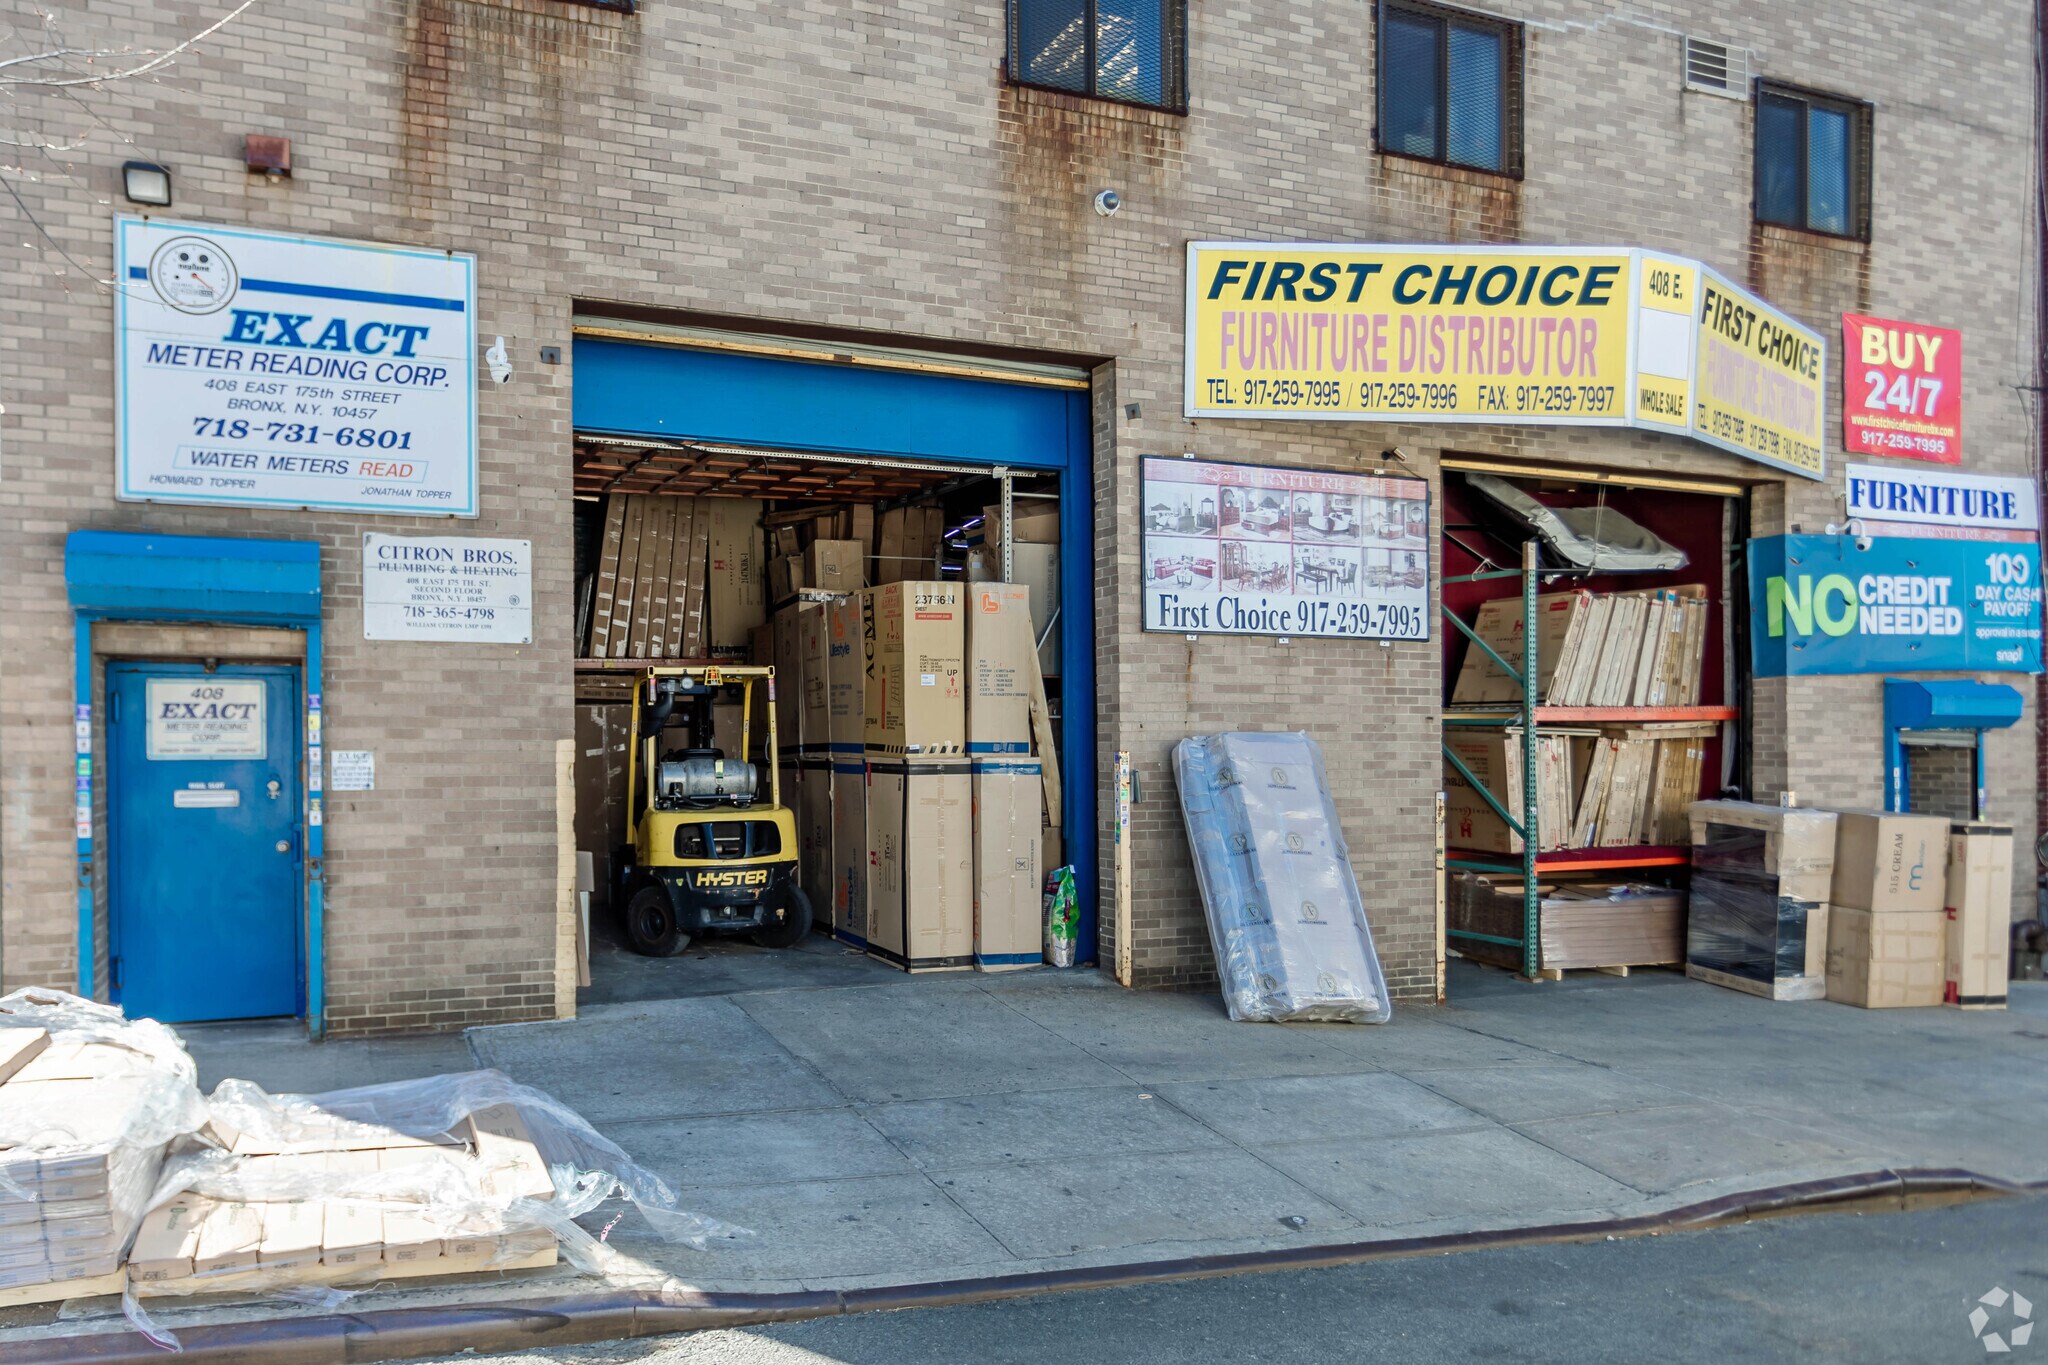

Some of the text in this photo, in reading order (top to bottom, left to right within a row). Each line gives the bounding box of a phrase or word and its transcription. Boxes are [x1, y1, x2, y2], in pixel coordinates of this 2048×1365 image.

[1207, 260, 1621, 306] FIRST CHOICE
[1649, 269, 1683, 299] 408 E.
[223, 308, 429, 358] EXACT
[1220, 311, 1598, 378] FURNITURE DISTRIBUTOR
[1700, 287, 1820, 381] FIRST CHOICE
[1861, 326, 1942, 373] BUY
[148, 343, 450, 388] METER READING CORP.
[204, 379, 401, 404] 408 EAST 175th STREET
[1207, 379, 1237, 405] TEL:
[1244, 380, 1340, 407] 917-259-7995
[1360, 382, 1457, 409] 917-259-7996
[1478, 385, 1510, 411] FAX:
[1516, 386, 1614, 413] 917-259-7997
[1640, 388, 1683, 417] WHOLE SALE
[1864, 371, 1942, 417] 24/7
[295, 402, 323, 416] N.Y.
[331, 405, 377, 420] 10457
[193, 416, 412, 450] 718-731-6801
[1851, 414, 1954, 437] www.firstchoicefurniturebx.com
[1861, 430, 1945, 454] 917-259-7995
[190, 450, 413, 478] WATER METERS READ
[150, 474, 256, 489] HOWARD TOPPER
[1237, 470, 1345, 490] FURNITURE
[361, 486, 452, 500] JONATHAN TOPPER
[1849, 477, 2018, 520] FURNITURE
[1910, 526, 1981, 540] FURNITURE
[378, 545, 517, 565] CITRON BROS.
[378, 562, 517, 577] PLUMBING & HEATING
[1985, 553, 2029, 584] 100
[406, 577, 419, 585] 408
[422, 578, 445, 586] EAST
[415, 586, 483, 595] SECOND FLOOR
[1975, 585, 2041, 602] DAY CASH
[467, 596, 488, 604] 10457
[1767, 574, 1951, 637] NO CREDIT
[1984, 601, 2031, 617] PAYOFF
[403, 606, 495, 620] 718-365-4798
[1159, 593, 1421, 637] First Choice 917-259-7995
[1860, 606, 1963, 636] NEEDED
[863, 593, 876, 680] ACME
[1976, 627, 2008, 639] approval
[2008, 627, 2015, 637] in
[947, 669, 958, 677] UP
[190, 687, 224, 700] 408
[159, 703, 257, 719] EXACT
[166, 722, 248, 732] METER READING
[1889, 833, 1904, 894] 515 CREAM
[696, 869, 768, 887] HYSTER
